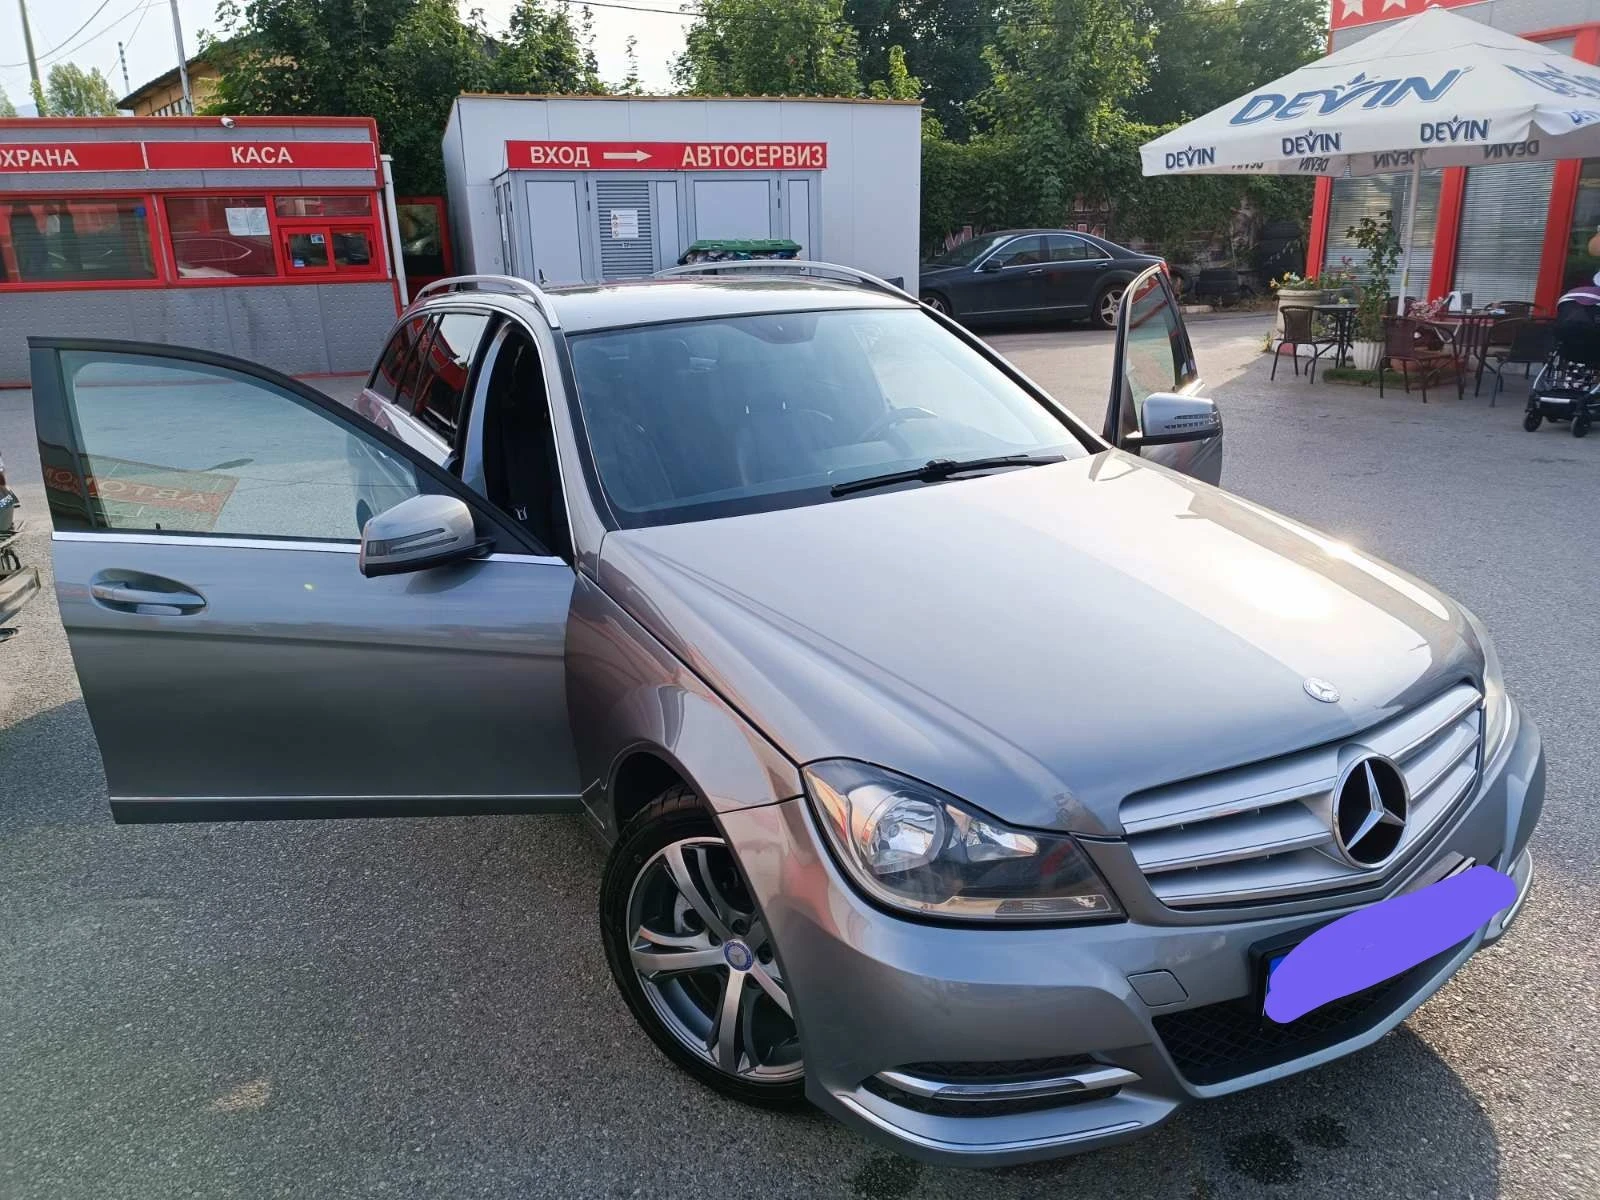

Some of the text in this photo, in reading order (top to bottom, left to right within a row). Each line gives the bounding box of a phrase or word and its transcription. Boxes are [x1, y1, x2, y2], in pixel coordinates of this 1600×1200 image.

[1229, 67, 1465, 127] DEVIN
[1419, 118, 1489, 142] DEVIN
[1281, 131, 1341, 155] DEVIN
[0, 149, 79, 167] ХРАНА
[231, 146, 294, 164] КАСА
[530, 145, 823, 168] ВХОД АВТОСЕРВИЗ
[1165, 146, 1216, 169] DEVIN
